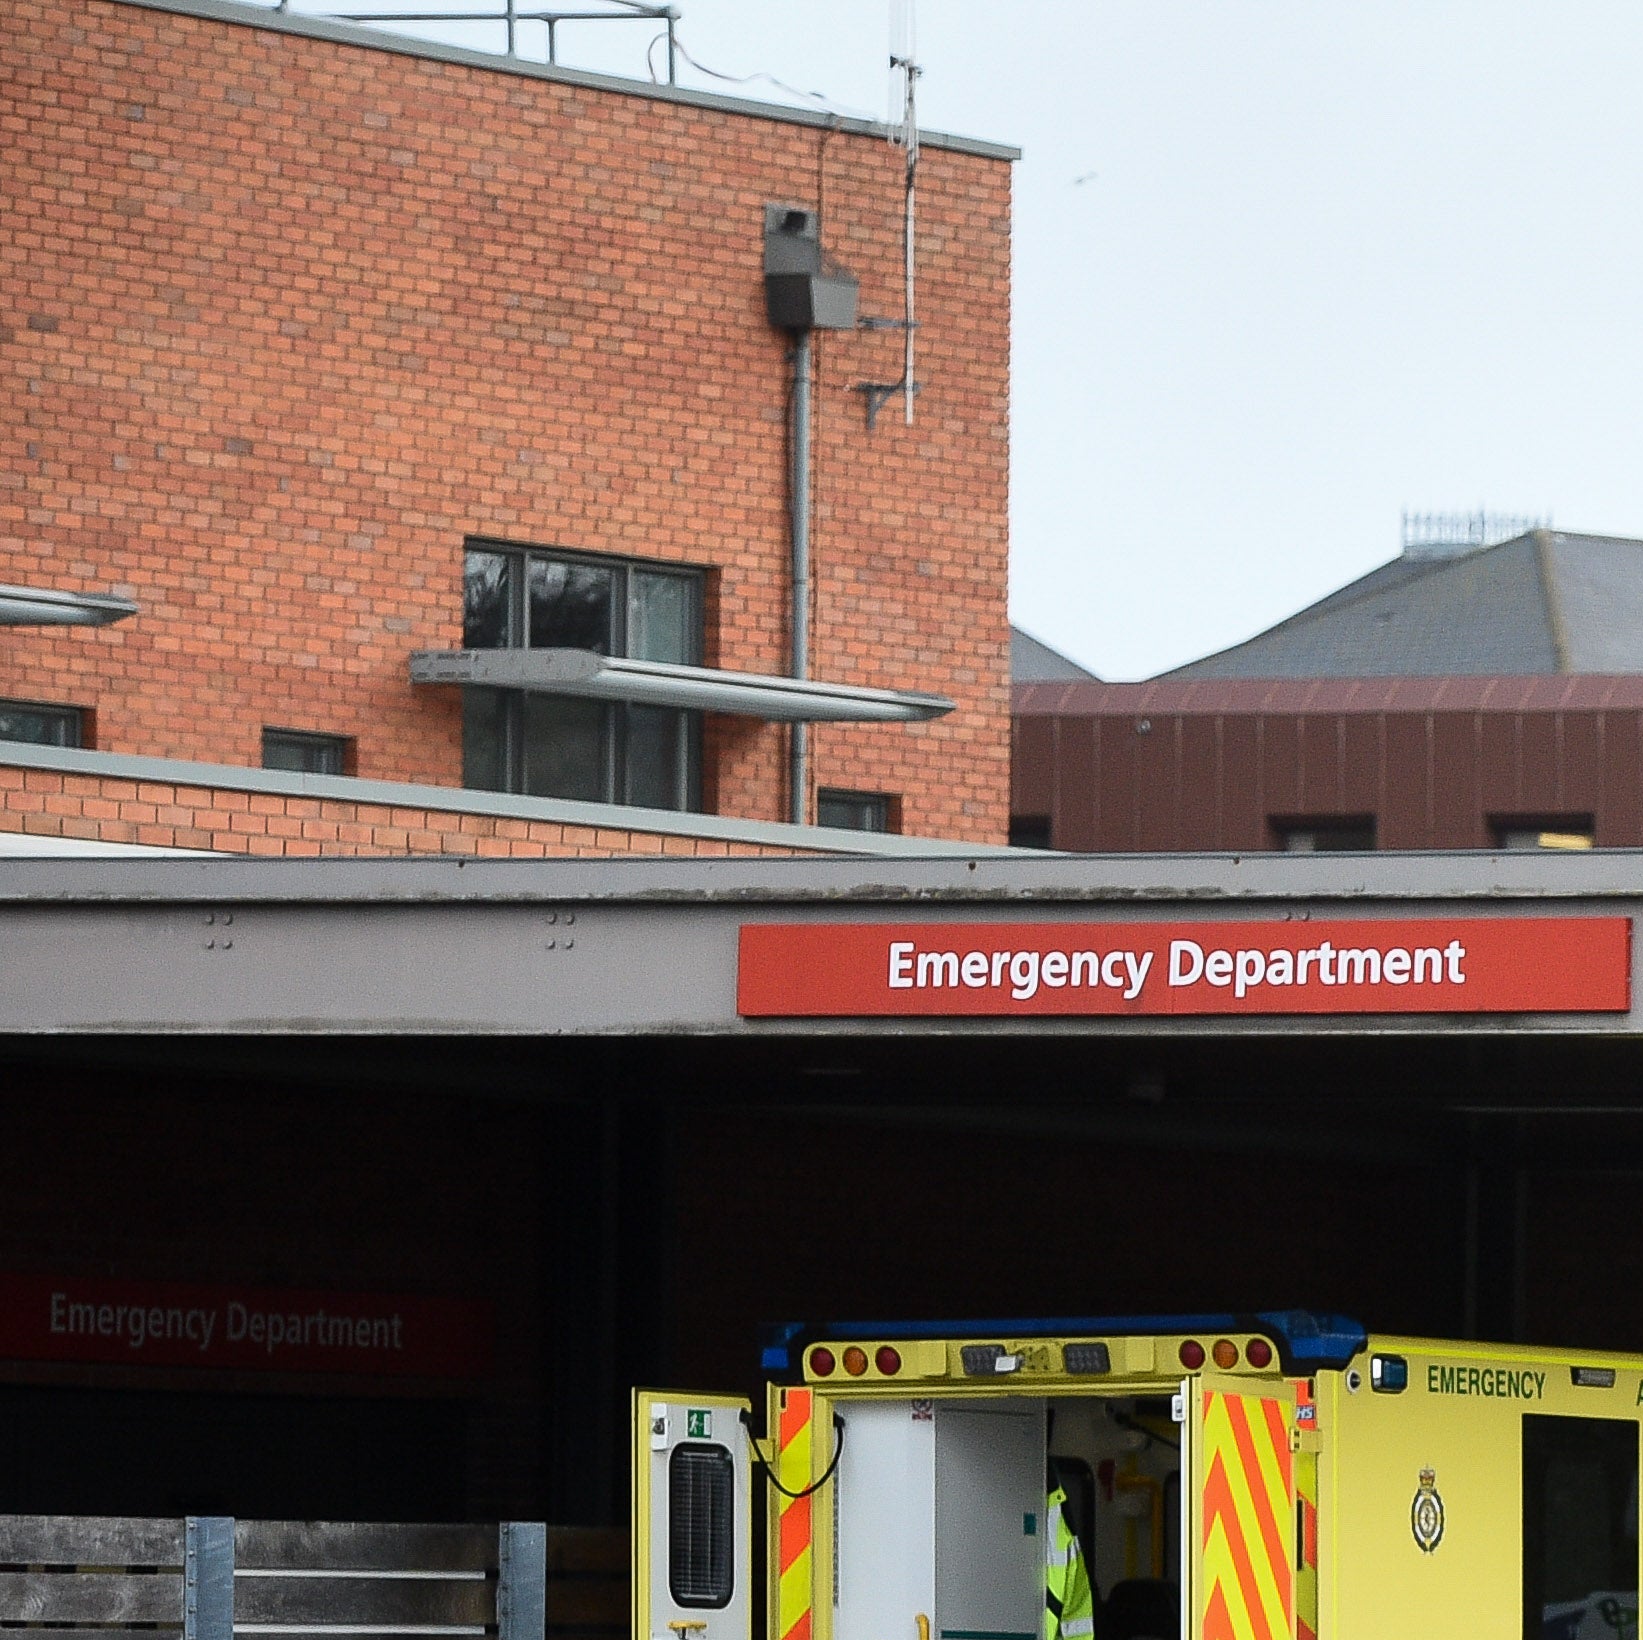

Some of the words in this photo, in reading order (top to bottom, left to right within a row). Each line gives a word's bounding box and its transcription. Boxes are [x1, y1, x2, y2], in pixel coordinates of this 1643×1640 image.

[887, 940, 1154, 1000] Emergency
[1167, 938, 1467, 998] Department
[50, 1292, 216, 1351] Emergency
[227, 1301, 403, 1353] Department
[1427, 1365, 1546, 1400] EMERGENCY
